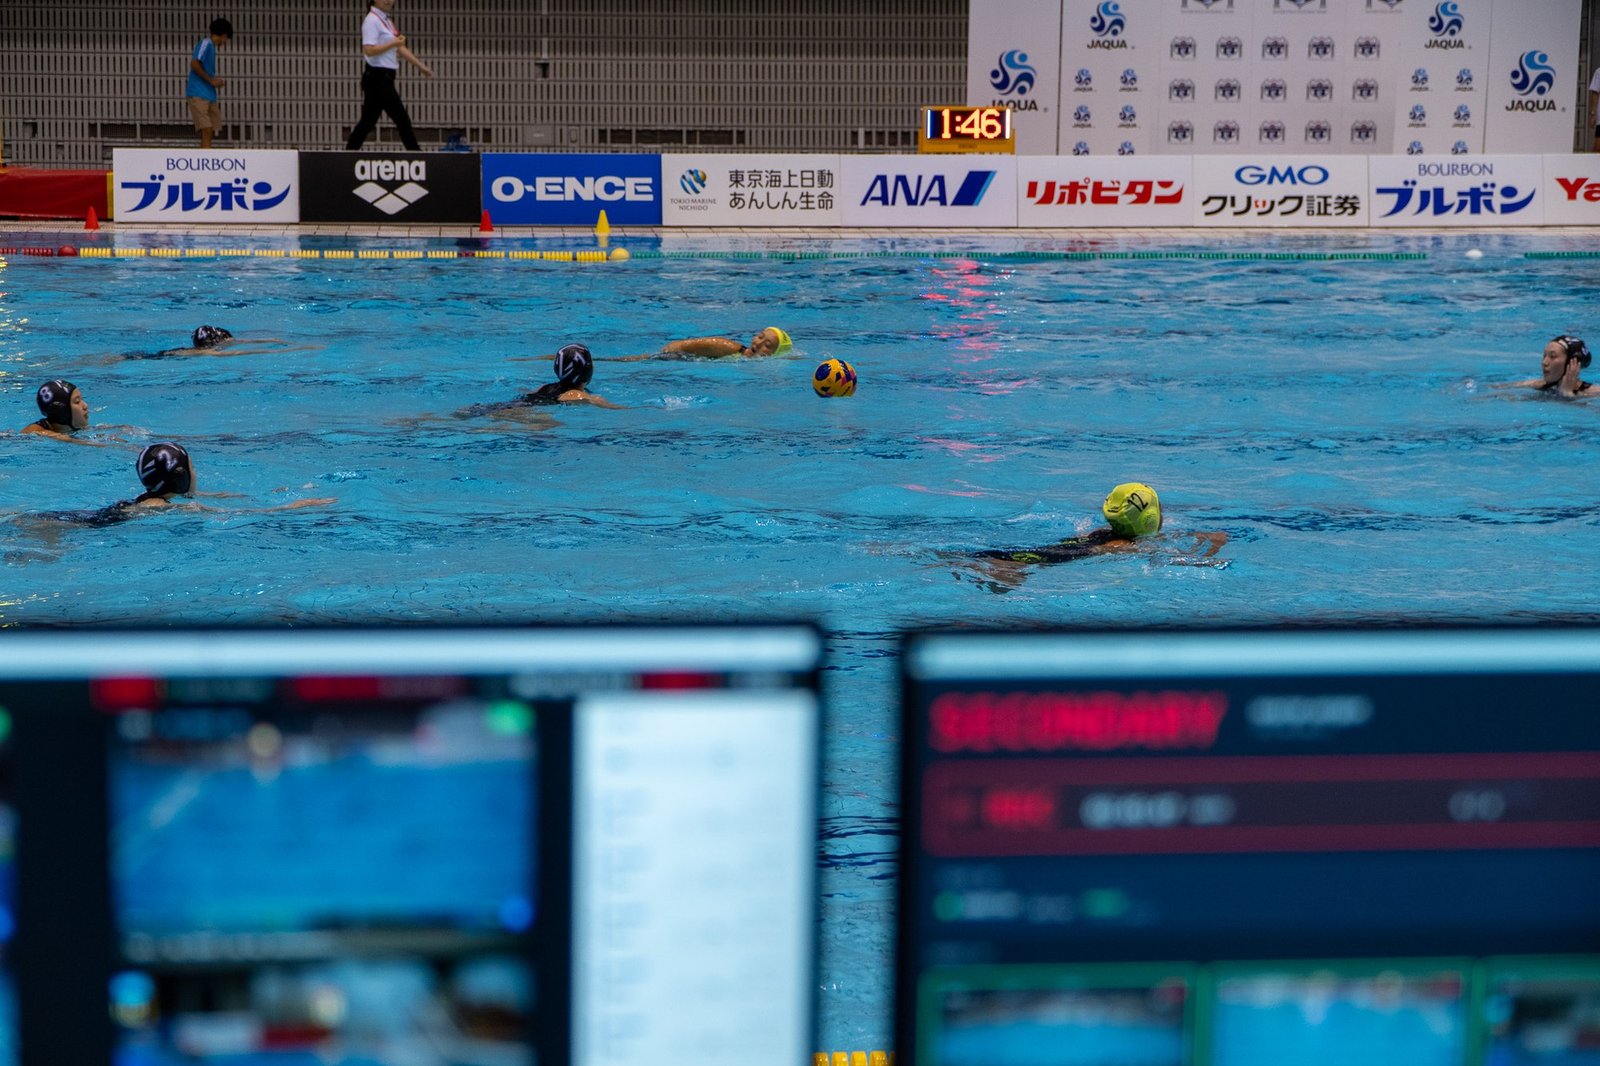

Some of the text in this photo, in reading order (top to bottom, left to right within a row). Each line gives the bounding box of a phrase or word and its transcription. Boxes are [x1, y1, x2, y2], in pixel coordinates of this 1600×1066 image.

[1087, 39, 1127, 50] JAQUA
[1424, 39, 1464, 50] JAQUA
[1505, 99, 1557, 112] JAQUA
[941, 108, 1002, 139] 1:46
[166, 158, 246, 171] BOURBON
[355, 159, 426, 181] arena
[1418, 163, 1493, 176] BOURBON
[728, 169, 834, 188] 東京海上日動
[1234, 165, 1329, 185] GMO
[121, 174, 291, 213] ブルボン
[491, 176, 654, 202] O-ENCE
[860, 175, 948, 206] ANA
[1026, 177, 1185, 205] リポビタン
[1376, 180, 1536, 218] ブルボン
[728, 191, 834, 210] あんしん生命
[1202, 195, 1360, 216] クリック証券
[40, 386, 53, 402] 8
[1127, 492, 1148, 512] 12
